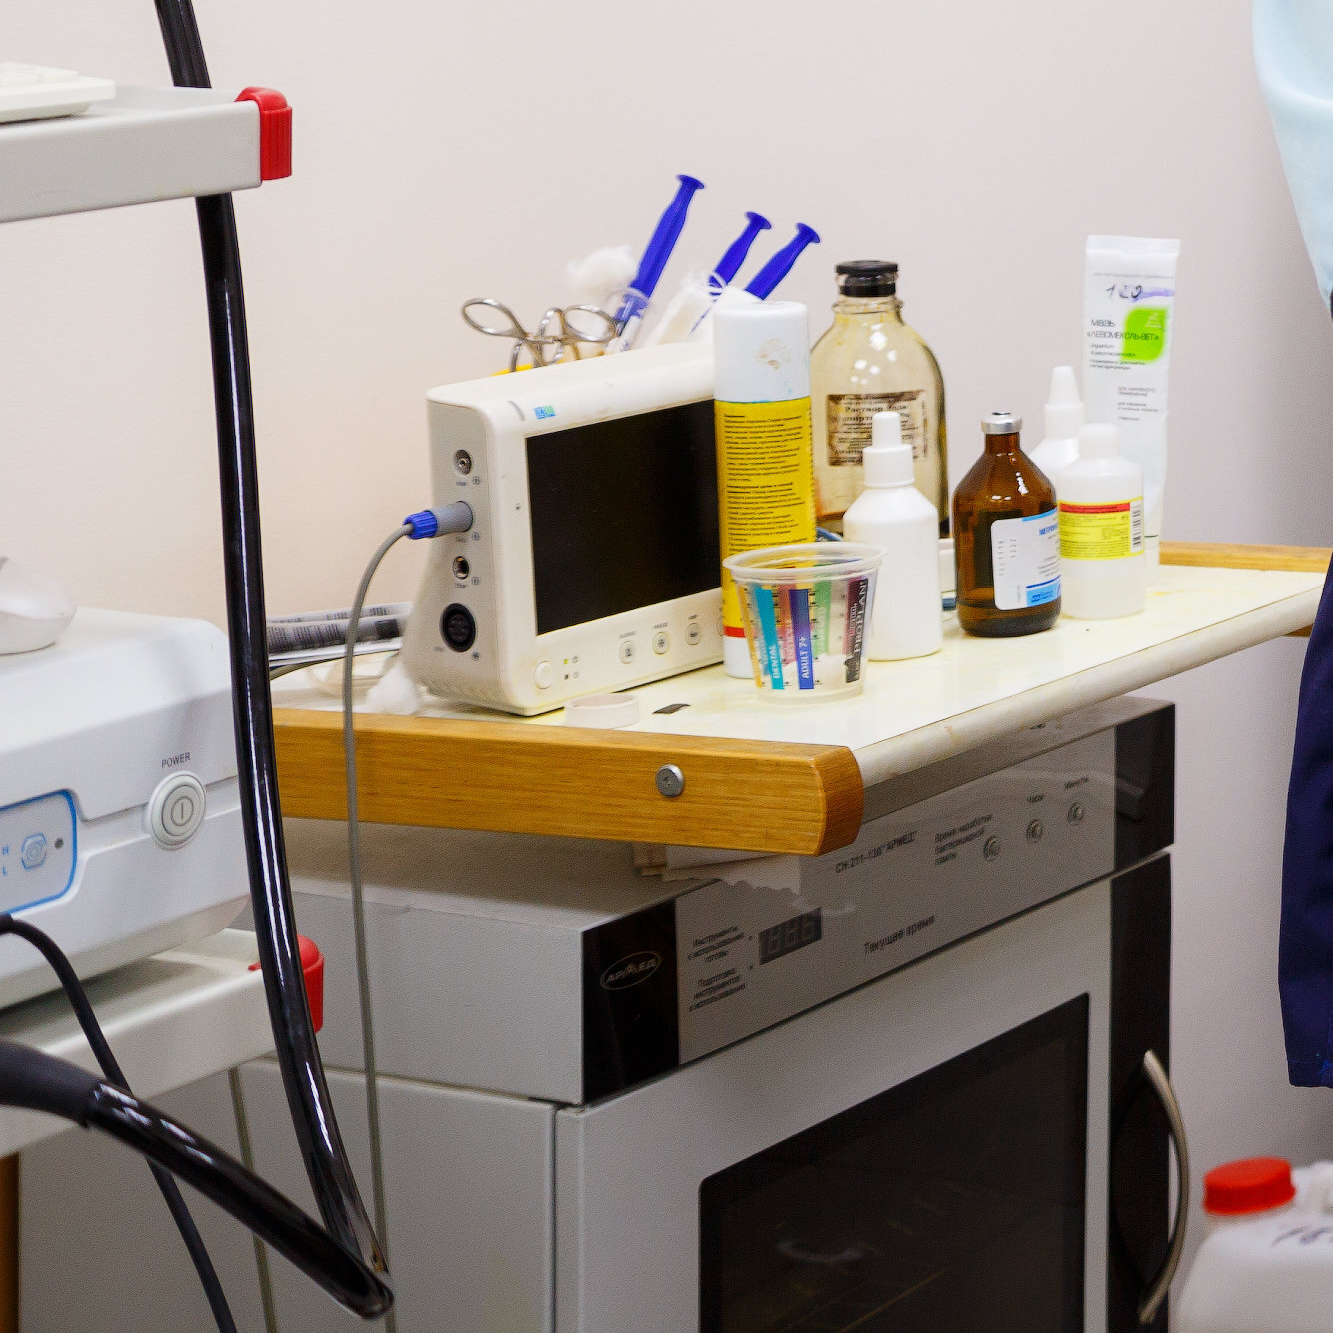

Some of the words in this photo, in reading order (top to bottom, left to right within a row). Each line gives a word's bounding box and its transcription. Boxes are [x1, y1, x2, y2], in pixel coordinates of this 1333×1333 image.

[801, 649, 811, 680] ADULT
[161, 752, 191, 768] POWER
[2, 847, 9, 855] H
[864, 930, 905, 954] Текущее
[905, 915, 935, 939] время
